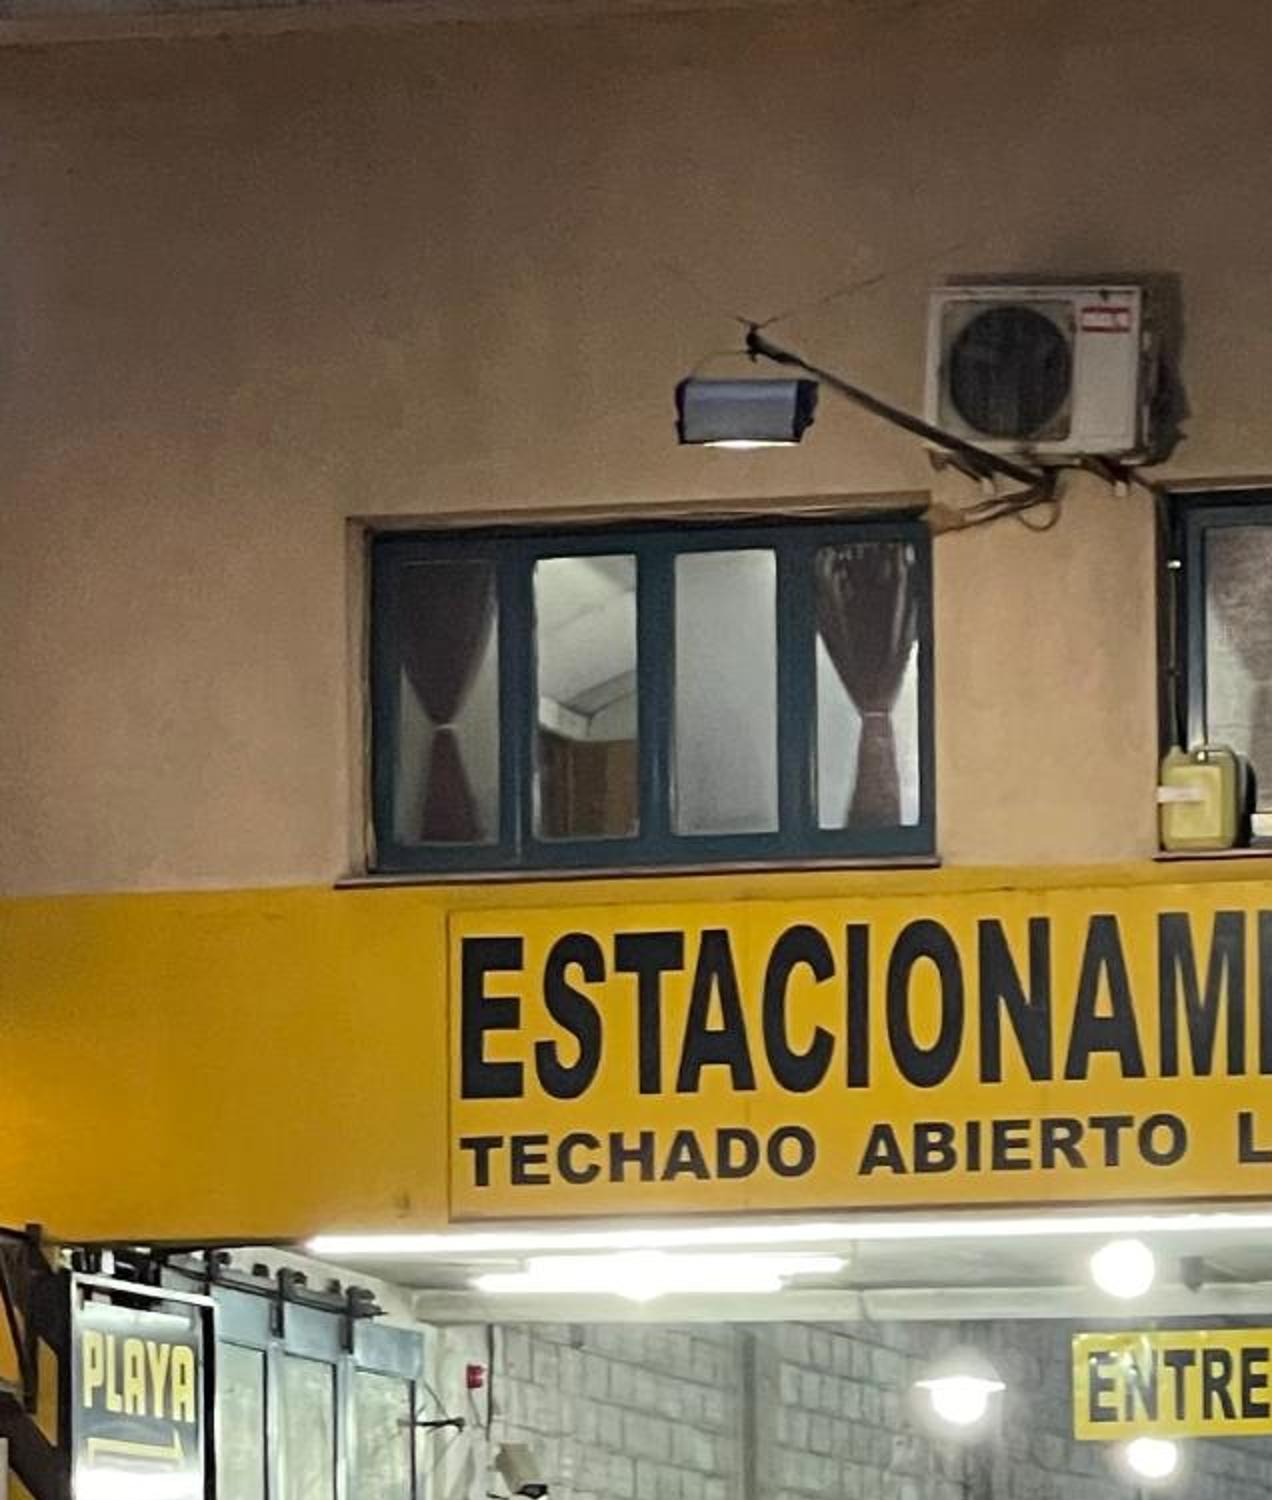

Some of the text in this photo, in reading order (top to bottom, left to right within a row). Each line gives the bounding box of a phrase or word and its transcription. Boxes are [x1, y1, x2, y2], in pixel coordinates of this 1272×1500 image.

[460, 1125, 816, 1187] TECHADO
[858, 1113, 1188, 1176] ABIERTO
[83, 1330, 195, 1423] PLAYA
[1088, 1346, 1270, 1422] ENTRE
